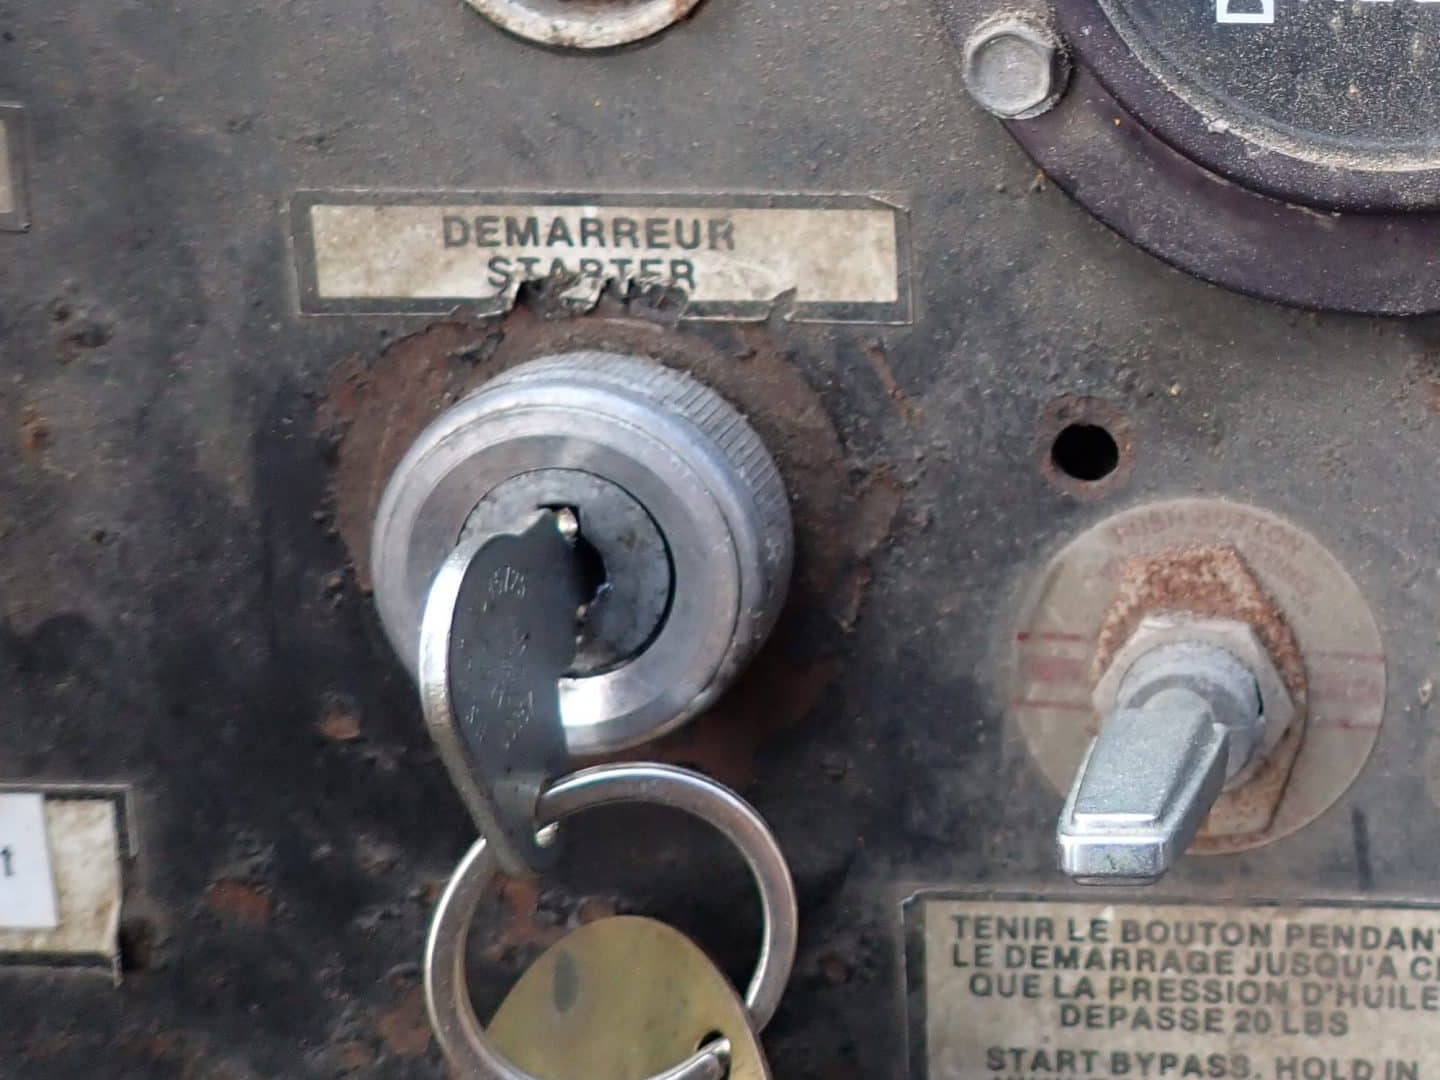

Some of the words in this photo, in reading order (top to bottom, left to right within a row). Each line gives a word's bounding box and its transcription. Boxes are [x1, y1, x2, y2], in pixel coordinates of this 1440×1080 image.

[443, 214, 736, 252] DEMARREUR
[950, 914, 1055, 943] TENIR
[1067, 917, 1110, 944] LE
[1121, 919, 1273, 948] BOUTON
[952, 943, 992, 969] LE
[1005, 945, 1235, 975] DEMARRAGE
[1244, 948, 1399, 981] JUSQU'A
[968, 973, 1047, 1000] QUE
[1053, 974, 1096, 1000] LA
[1106, 976, 1290, 1007] PRESSION
[1302, 981, 1440, 1012] D'HUILE
[1059, 1003, 1225, 1034] DEPASSE
[1233, 1007, 1273, 1035] 20
[1281, 1009, 1349, 1037] LBS
[985, 1046, 1098, 1073] START
[1274, 1056, 1377, 1080] HOLD
[1384, 1059, 1420, 1080] IN
